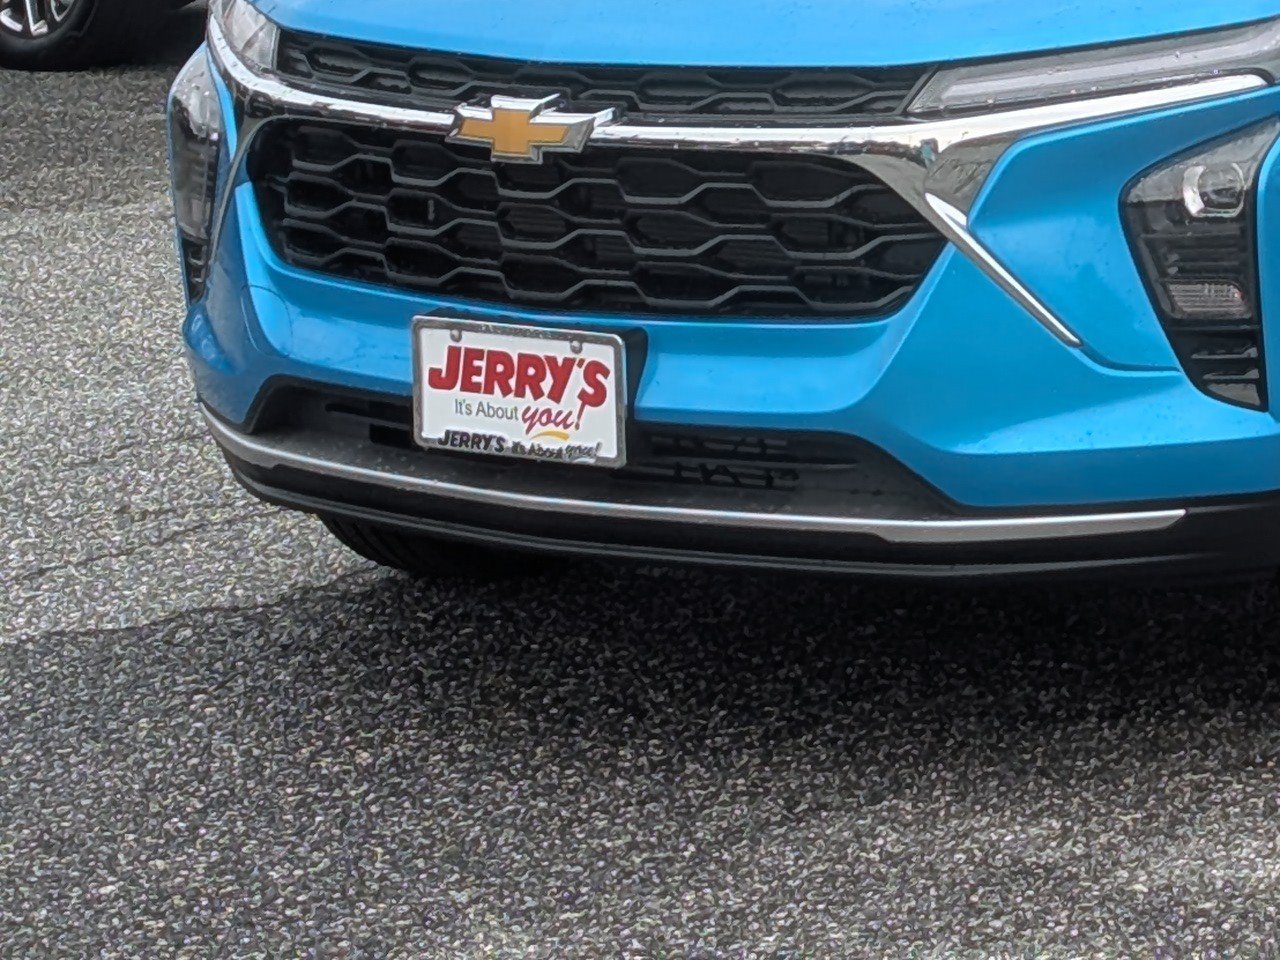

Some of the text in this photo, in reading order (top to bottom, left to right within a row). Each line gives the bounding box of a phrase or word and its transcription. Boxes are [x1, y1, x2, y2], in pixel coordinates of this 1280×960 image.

[428, 344, 611, 408] JERRY'S
[454, 399, 585, 435] It's About you!
[438, 429, 507, 453] JERRY'S
